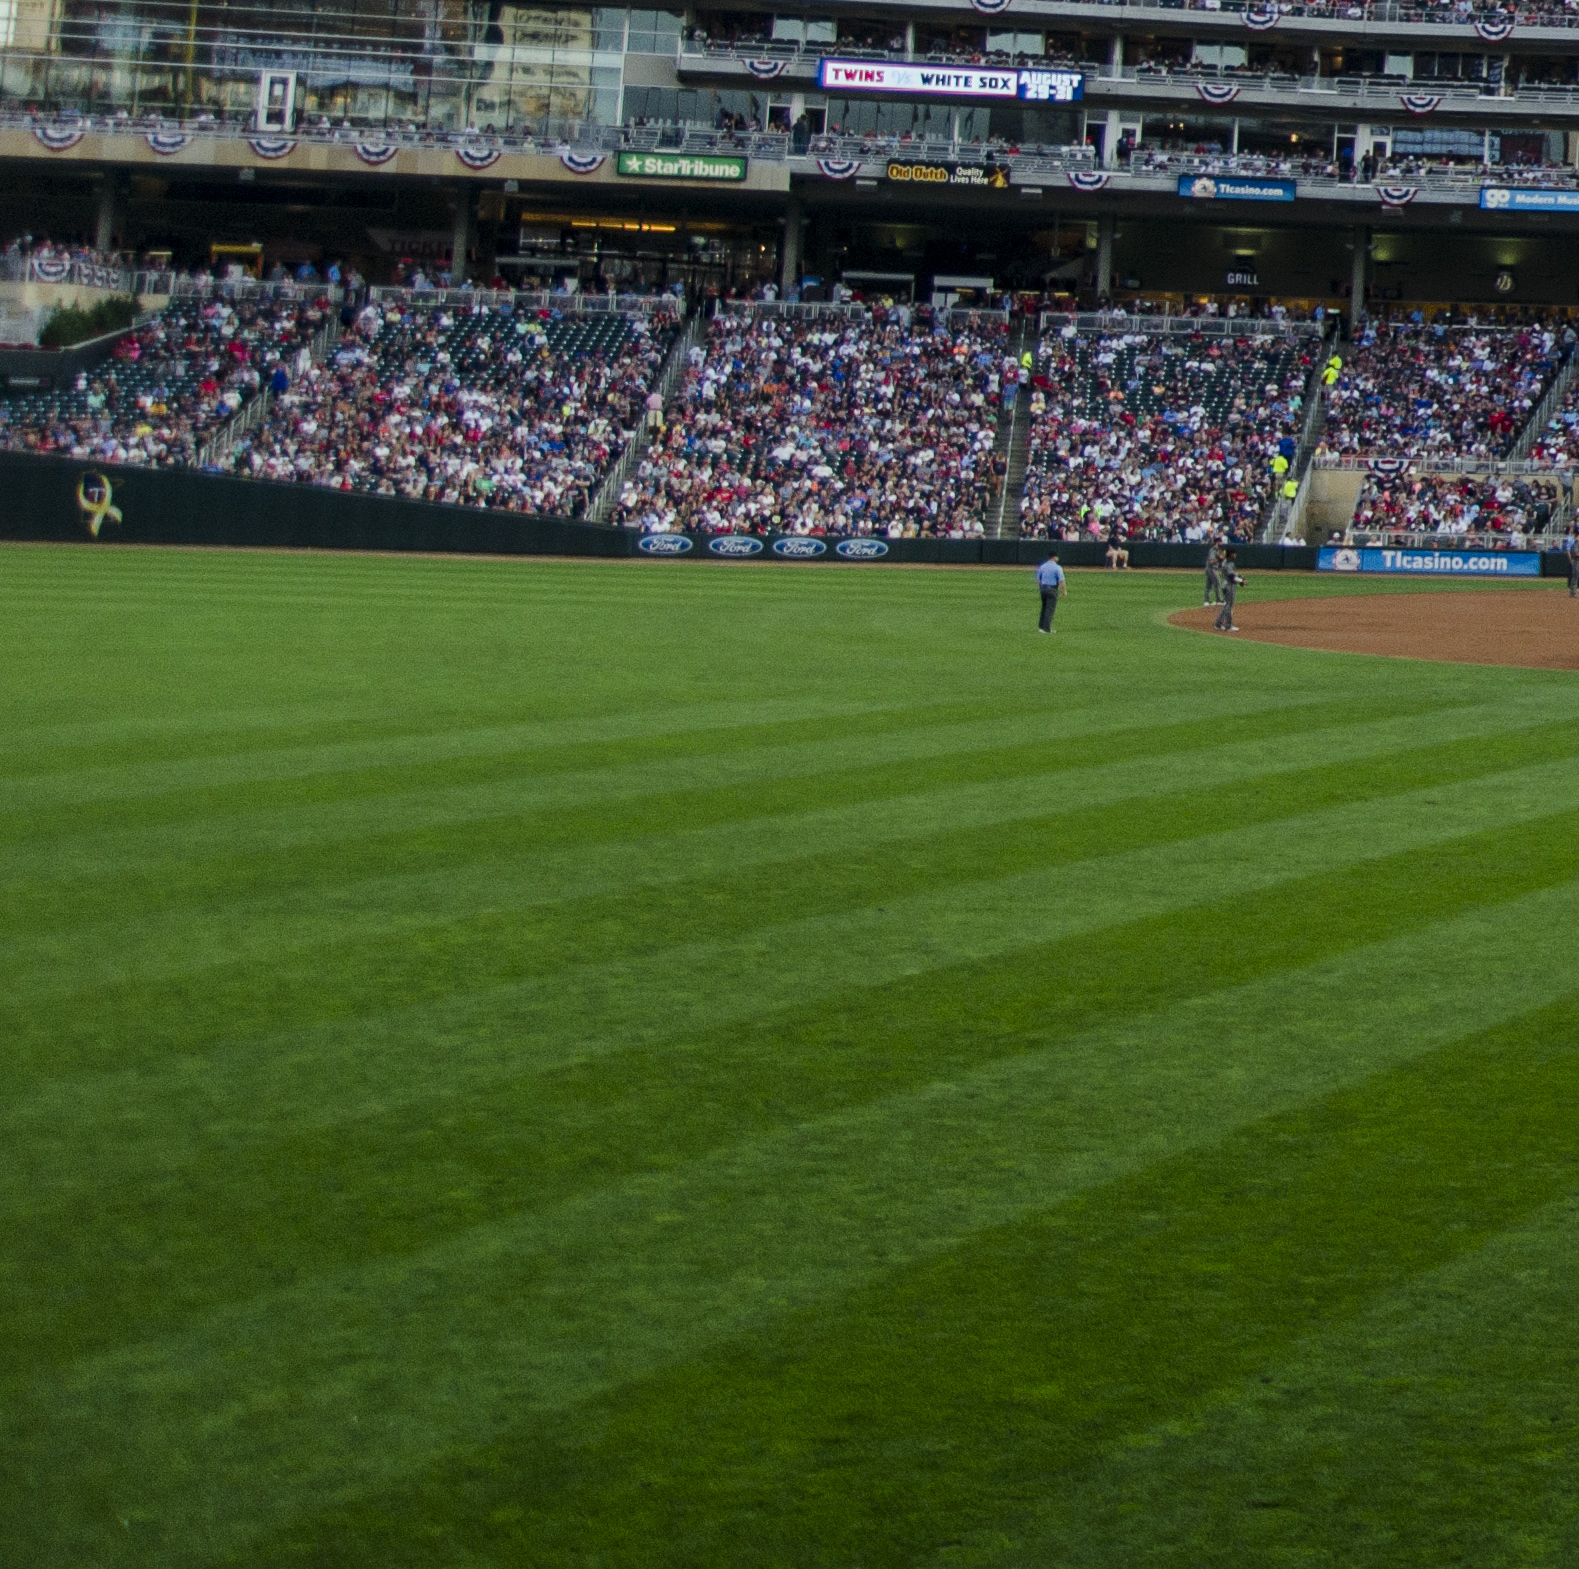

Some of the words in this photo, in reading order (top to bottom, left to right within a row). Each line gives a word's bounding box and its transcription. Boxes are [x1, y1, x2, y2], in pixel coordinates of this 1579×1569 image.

[832, 67, 885, 83] TWINS
[920, 72, 973, 88] WHITE
[978, 75, 1011, 90] SOX
[1019, 70, 1082, 88] AUGUST
[643, 157, 740, 178] StarTribune
[888, 164, 911, 180] Old
[912, 164, 948, 182] Dutch
[956, 166, 984, 177] Quality
[950, 175, 969, 184] Lives
[970, 175, 989, 184] Here
[1515, 194, 1555, 204] Modern
[1227, 273, 1260, 285] GRILL
[651, 536, 680, 552] Ford
[719, 538, 752, 554] Ford
[783, 539, 815, 555] Ford
[843, 540, 877, 556] Ford
